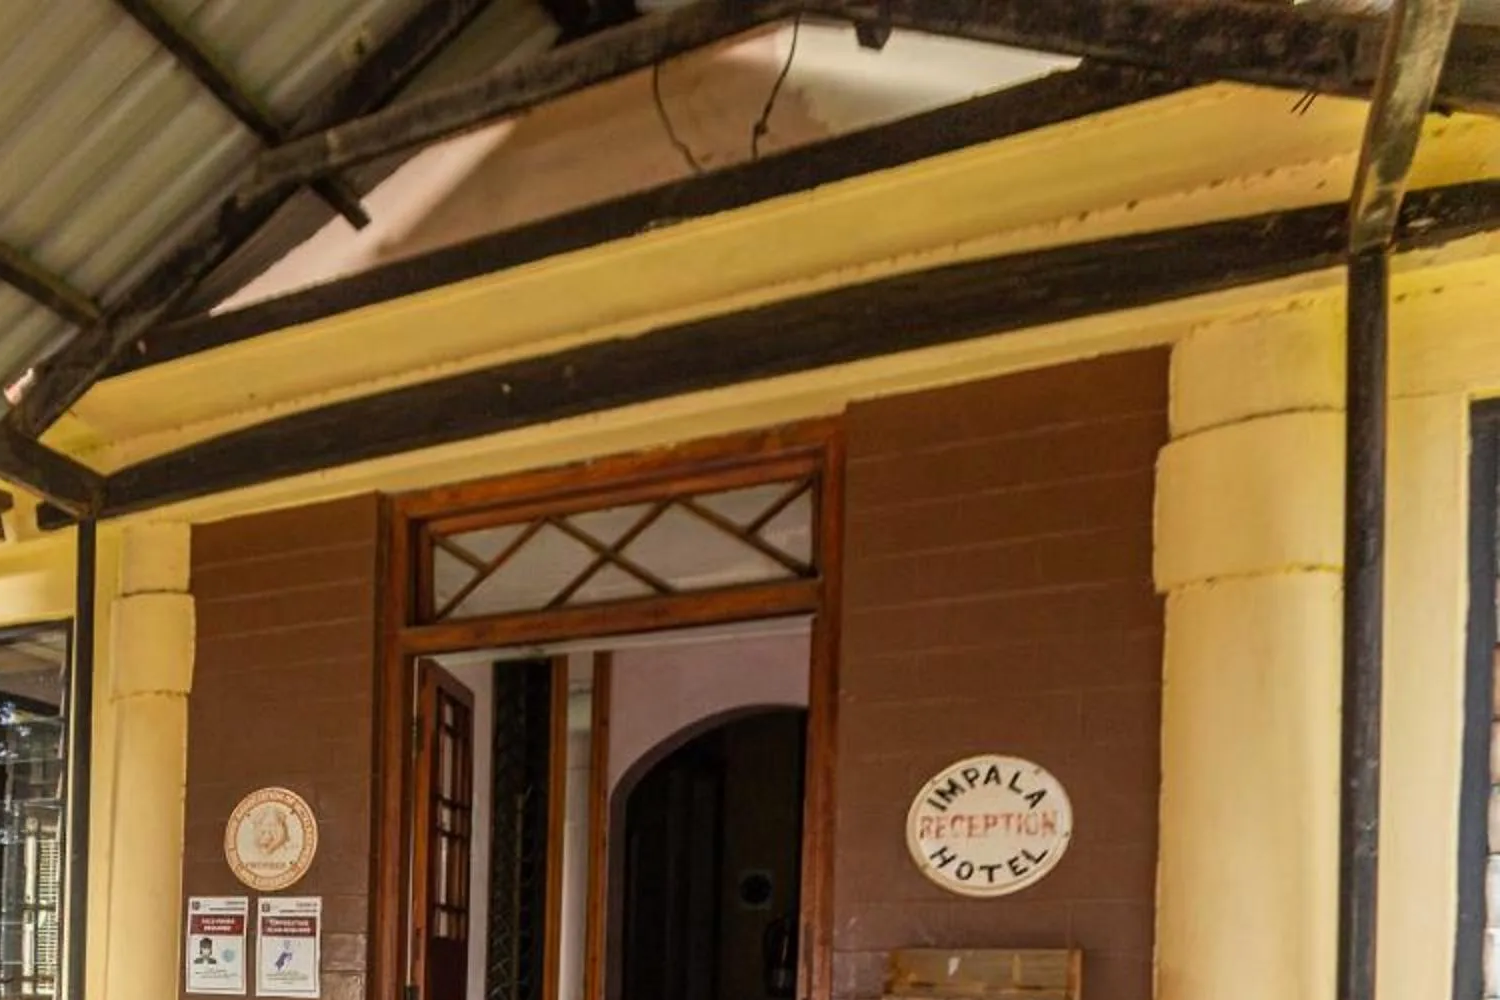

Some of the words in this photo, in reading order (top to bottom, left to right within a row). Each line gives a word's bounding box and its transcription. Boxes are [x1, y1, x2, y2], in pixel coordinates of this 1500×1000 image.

[927, 764, 1048, 812] IMPALA
[920, 810, 1057, 839] RECEPTION
[929, 846, 1048, 882] HOTEL
